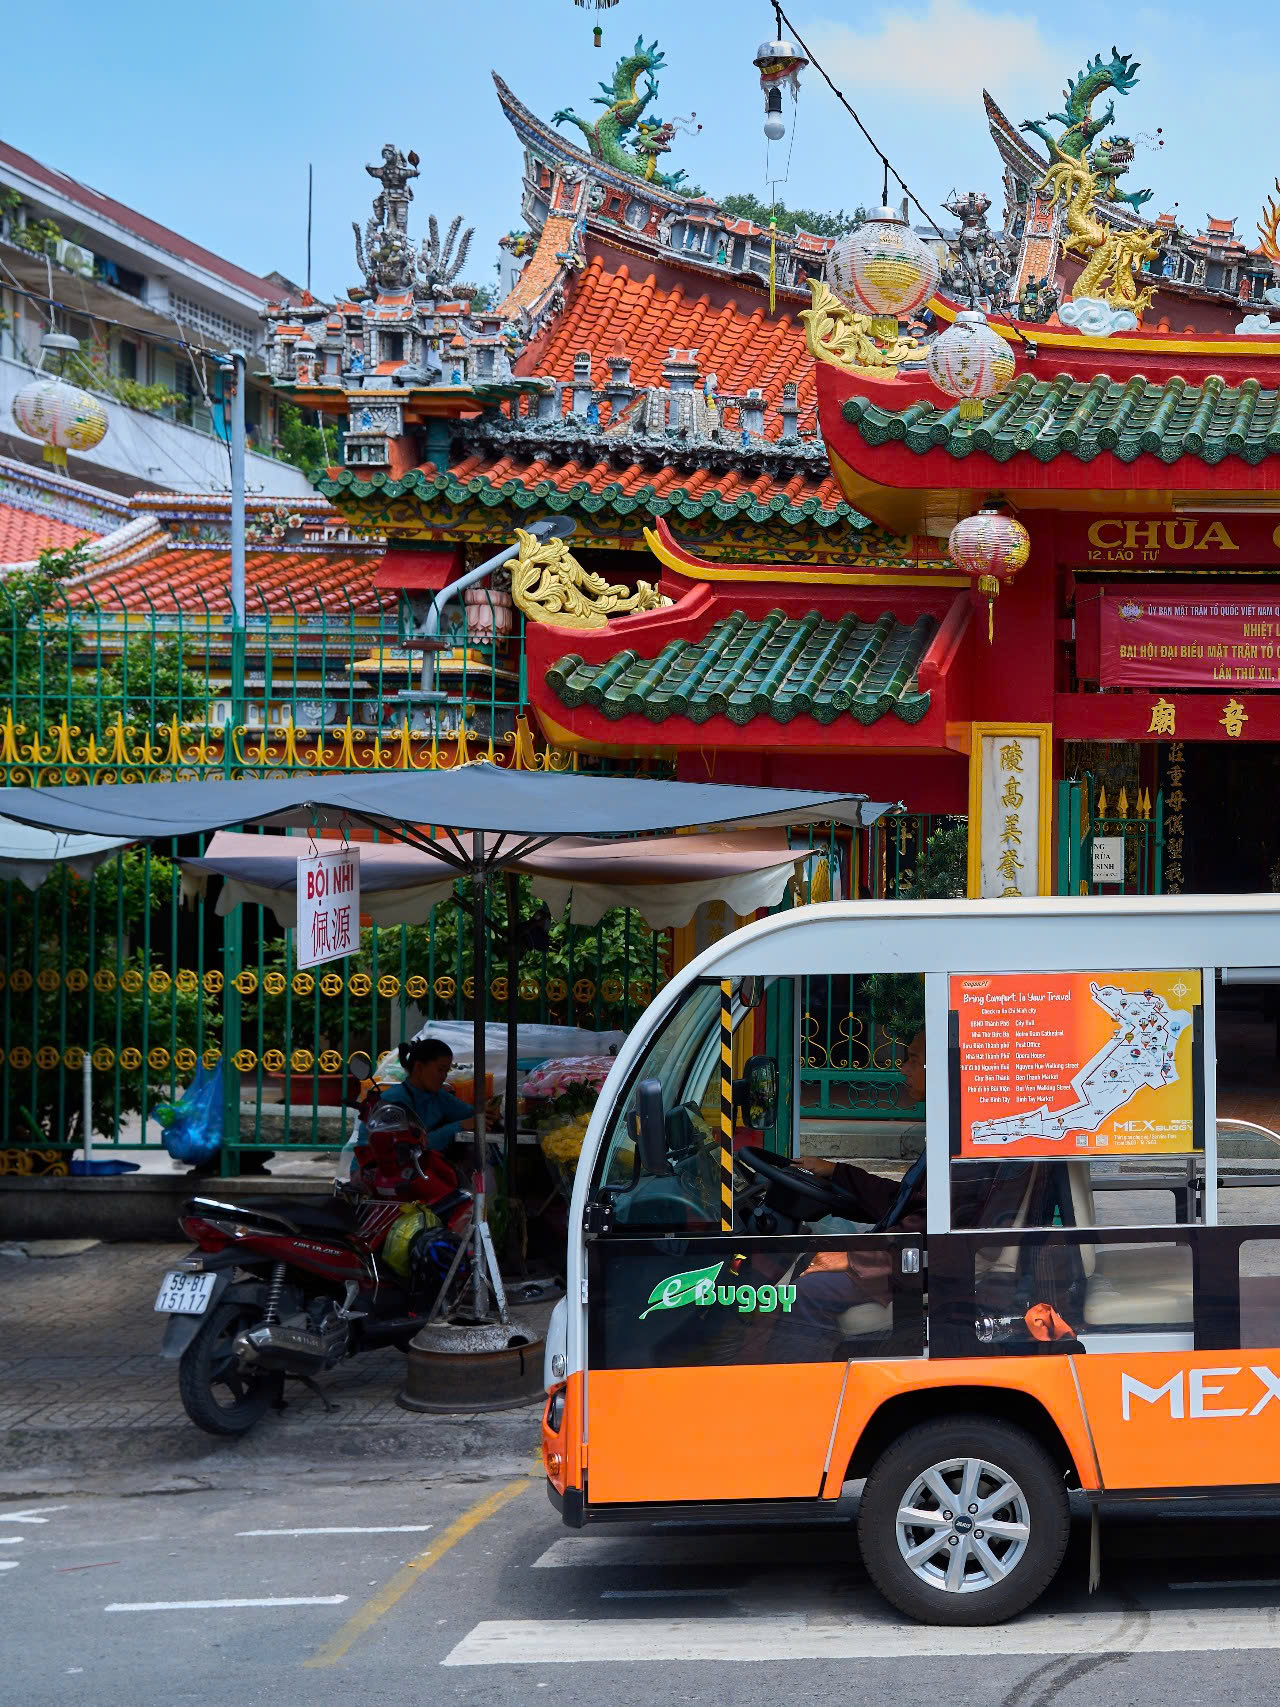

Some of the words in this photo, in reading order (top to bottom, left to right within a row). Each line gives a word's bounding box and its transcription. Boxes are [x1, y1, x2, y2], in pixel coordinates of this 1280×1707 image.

[1088, 517, 1240, 550] CHÙA
[1159, 606, 1172, 616] BAN
[1174, 605, 1188, 618] MẶT
[1190, 604, 1208, 618] TRẬN
[1209, 602, 1219, 616] TỔ
[1220, 602, 1239, 616] QUỐC
[1240, 604, 1256, 618] VIỆT
[1257, 606, 1273, 616] NAM
[1243, 621, 1273, 639] NHIỆT
[1120, 644, 1137, 660] ĐẠI
[1140, 643, 1158, 660] HỘI
[1161, 645, 1178, 660] ĐẠI
[1180, 639, 1204, 658] BIỂU
[1207, 643, 1228, 660] MẶT
[1232, 642, 1258, 660] TRẬN
[1261, 640, 1273, 658] TỔ
[1213, 663, 1232, 680] LẦN
[1235, 664, 1256, 680] THỨ
[1258, 667, 1275, 682] XII,
[307, 861, 329, 906] BỘI
[333, 863, 354, 895] NHI
[963, 993, 984, 1005] Bring
[1027, 992, 1046, 1002] Your
[1046, 989, 1071, 1001] Travel
[1015, 1052, 1030, 1060] Opera
[1044, 1062, 1064, 1070] Walking
[1036, 1084, 1056, 1092] Walking
[1113, 1119, 1156, 1132] MEX
[170, 1274, 206, 1292] 59-B1
[160, 1293, 206, 1310] 151.17
[695, 1277, 797, 1313] Buggy
